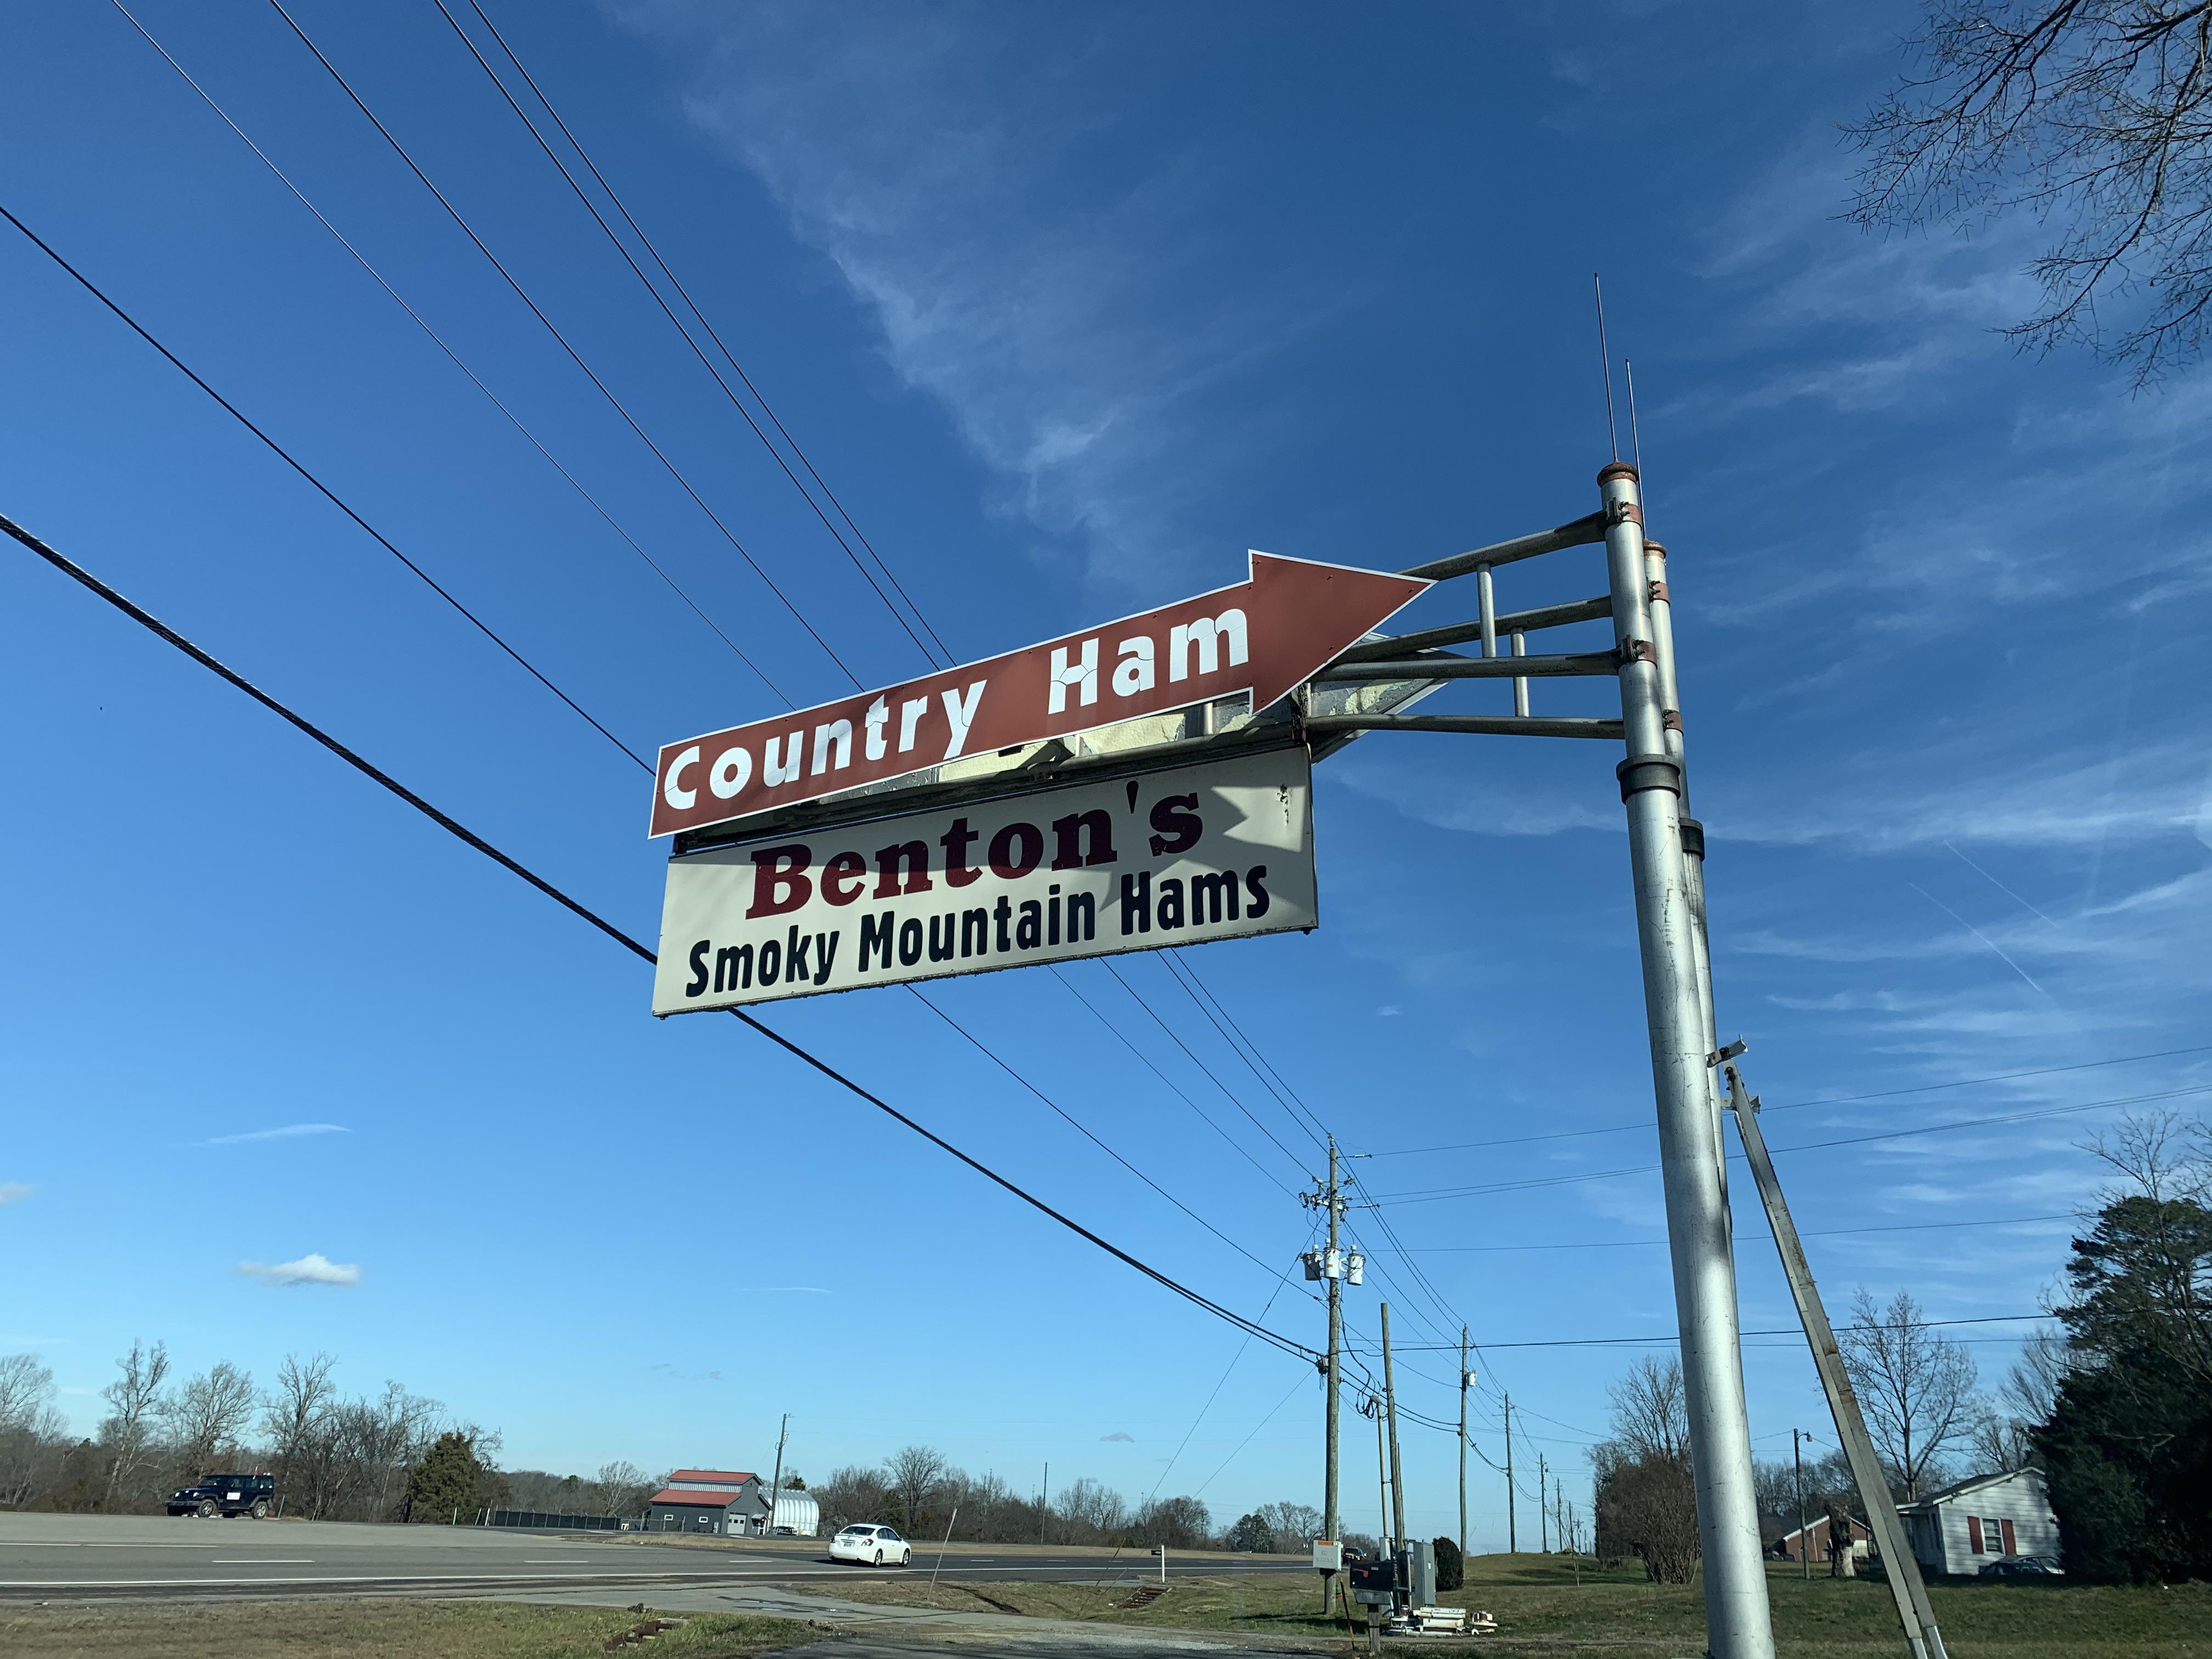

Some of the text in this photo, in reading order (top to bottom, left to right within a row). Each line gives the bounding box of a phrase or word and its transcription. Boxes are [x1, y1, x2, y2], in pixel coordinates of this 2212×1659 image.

[664, 607, 1249, 810] Country Ham
[746, 782, 1203, 919] Benton's
[685, 865, 1269, 998] Smoky Mountain Hams
